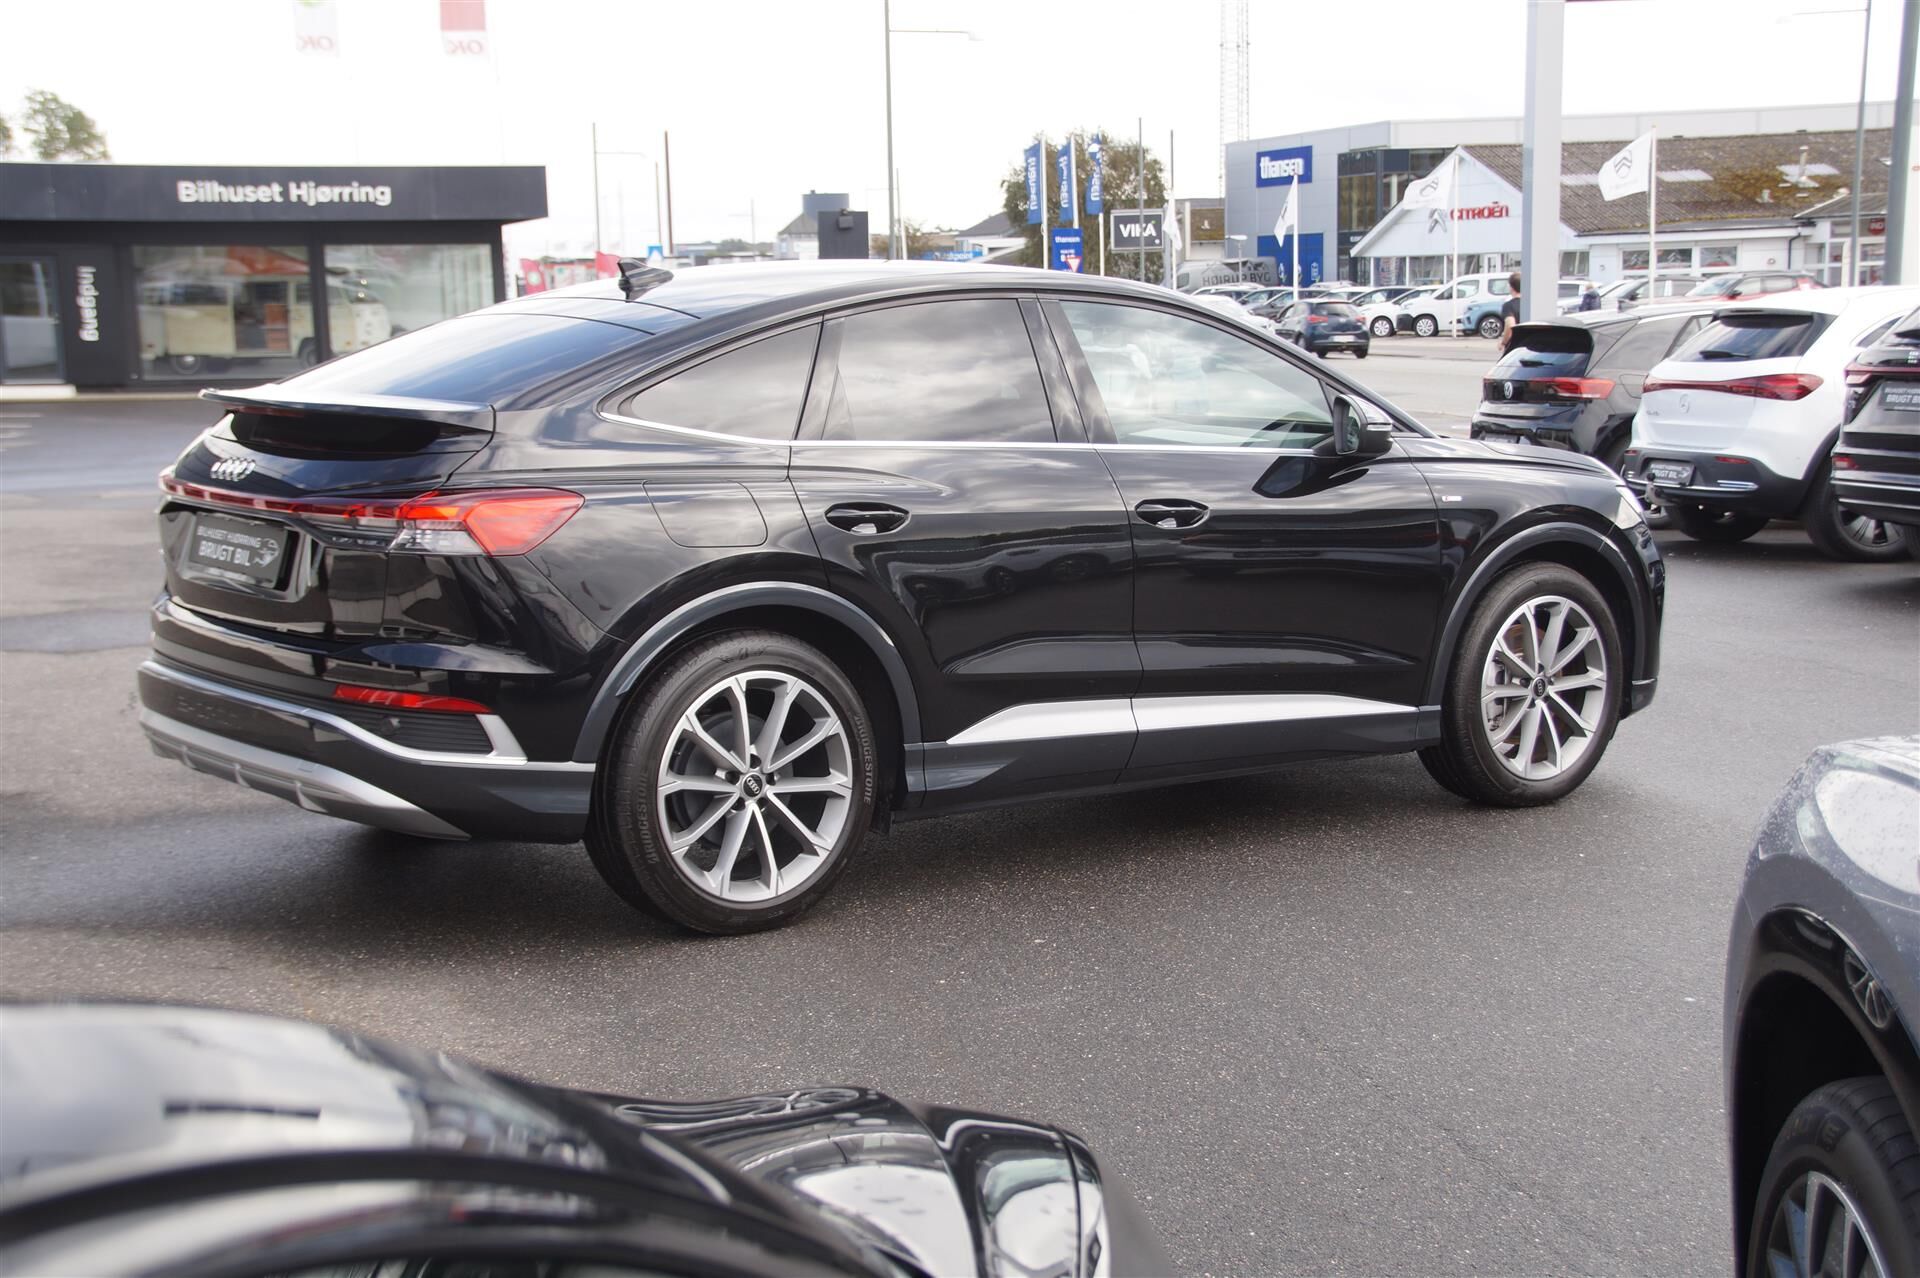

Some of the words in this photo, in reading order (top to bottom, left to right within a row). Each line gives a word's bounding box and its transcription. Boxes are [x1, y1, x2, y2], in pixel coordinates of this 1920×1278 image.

[1260, 156, 1304, 179] thansen
[176, 180, 284, 203] Bilhuset
[288, 181, 392, 206] Hjørring
[1450, 200, 1509, 220] CITROËN
[1250, 271, 1271, 283] BYG
[77, 265, 99, 341] Indgang
[199, 540, 235, 562] BRUGT
[233, 548, 251, 567] BIL
[854, 714, 874, 806] BRIDGESTONE
